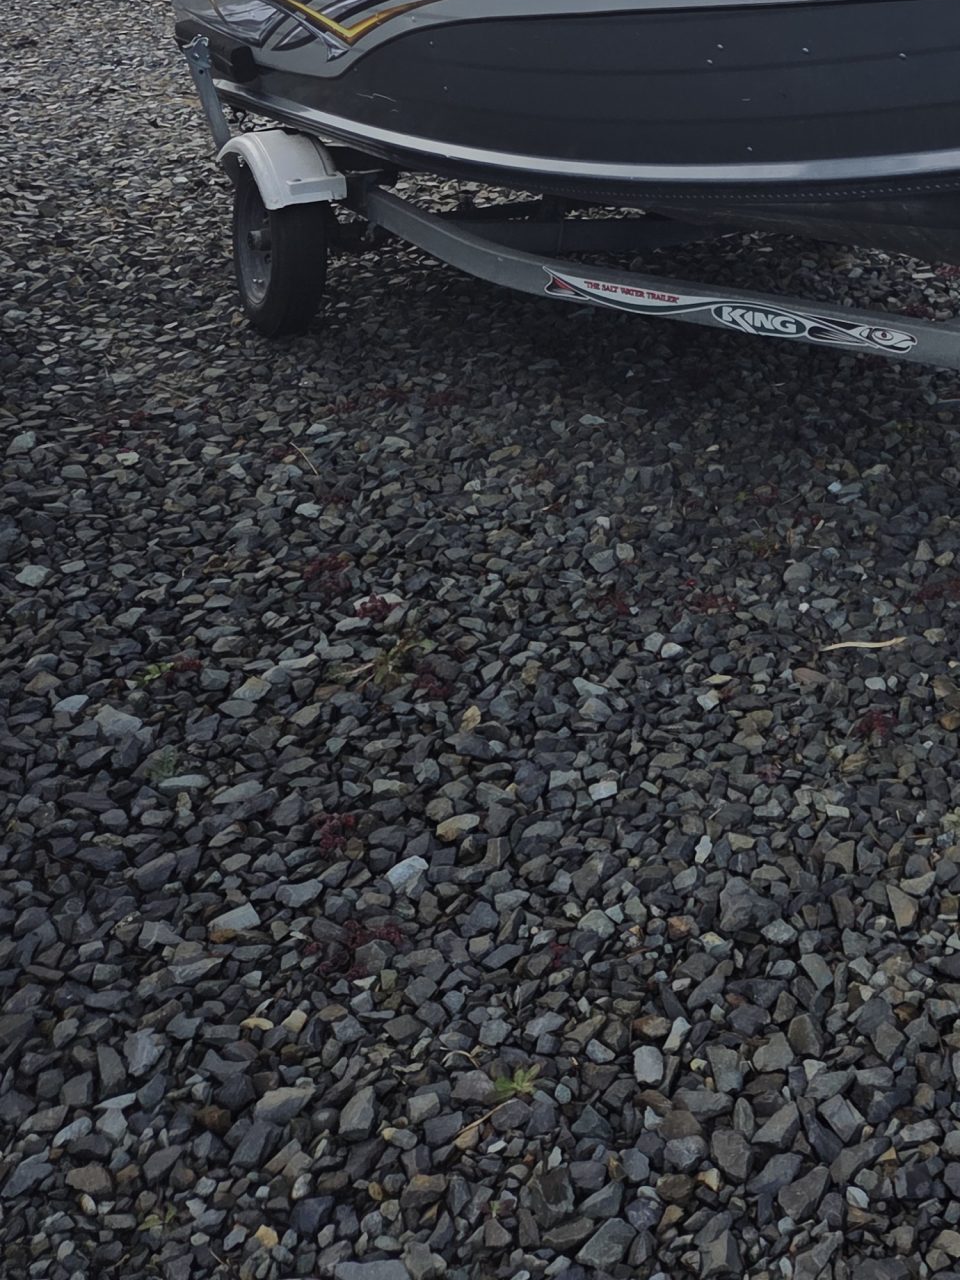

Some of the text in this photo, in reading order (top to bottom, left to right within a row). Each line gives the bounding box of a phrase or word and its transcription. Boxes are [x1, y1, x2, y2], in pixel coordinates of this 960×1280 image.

[601, 283, 619, 294] SALT
[620, 286, 645, 298] WATER
[721, 306, 797, 334] KING
